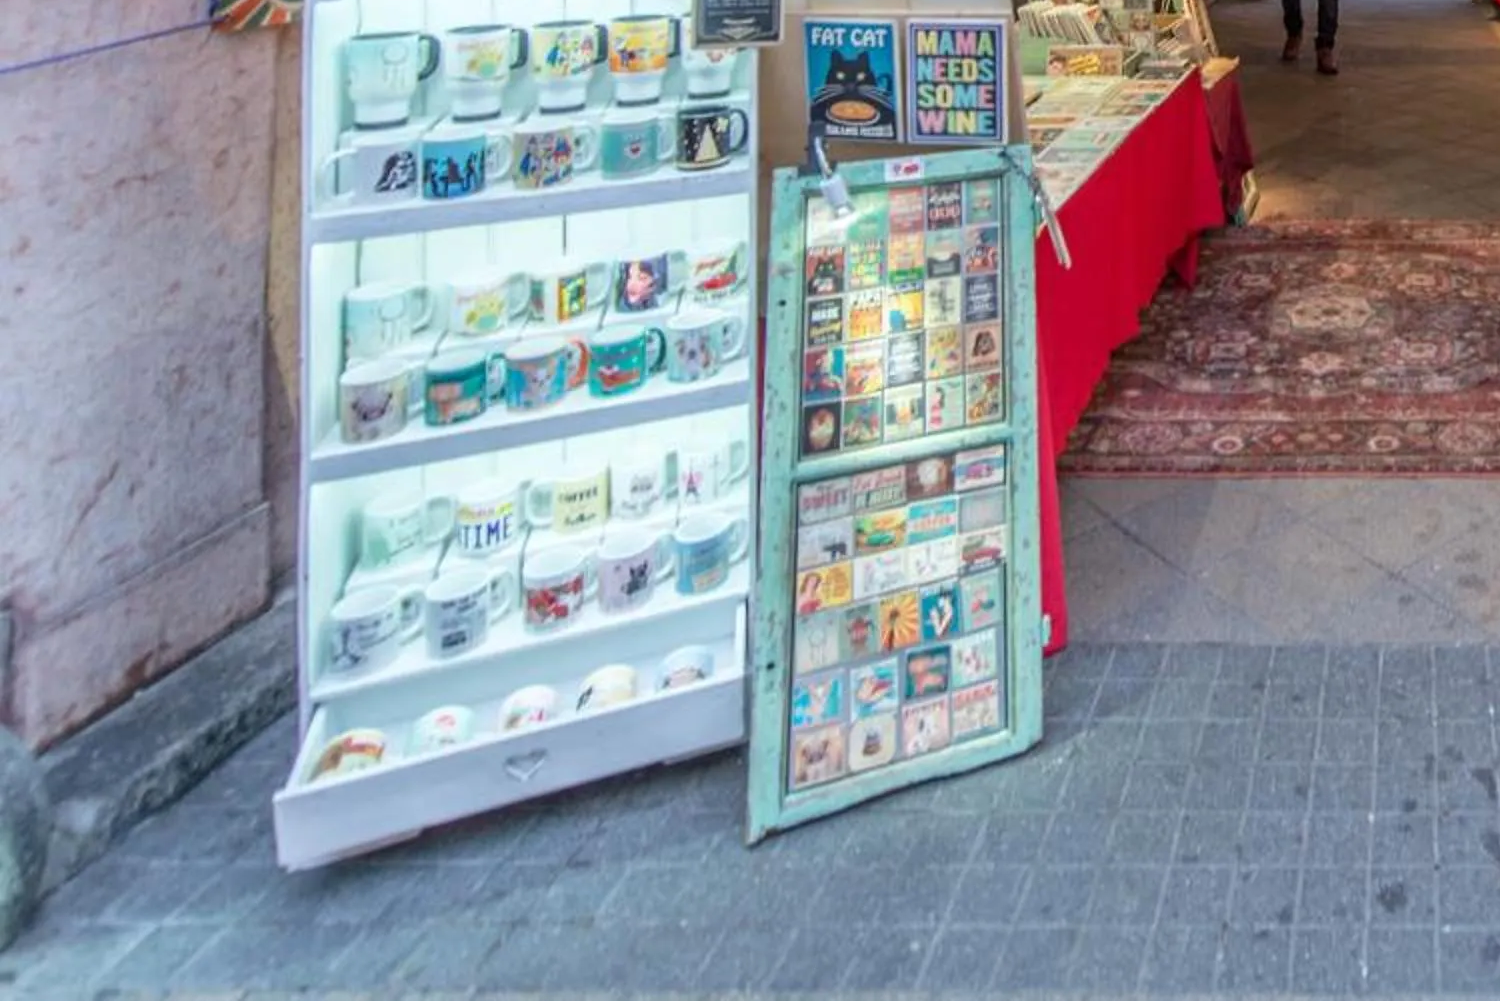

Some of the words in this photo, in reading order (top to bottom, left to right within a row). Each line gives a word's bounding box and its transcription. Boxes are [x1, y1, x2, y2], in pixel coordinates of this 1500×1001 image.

[811, 26, 847, 48] FAT
[850, 27, 888, 48] CAT
[917, 29, 994, 56] MAMA
[917, 56, 995, 83] NEEDS
[918, 83, 995, 109] SOME
[918, 108, 994, 135] WINE
